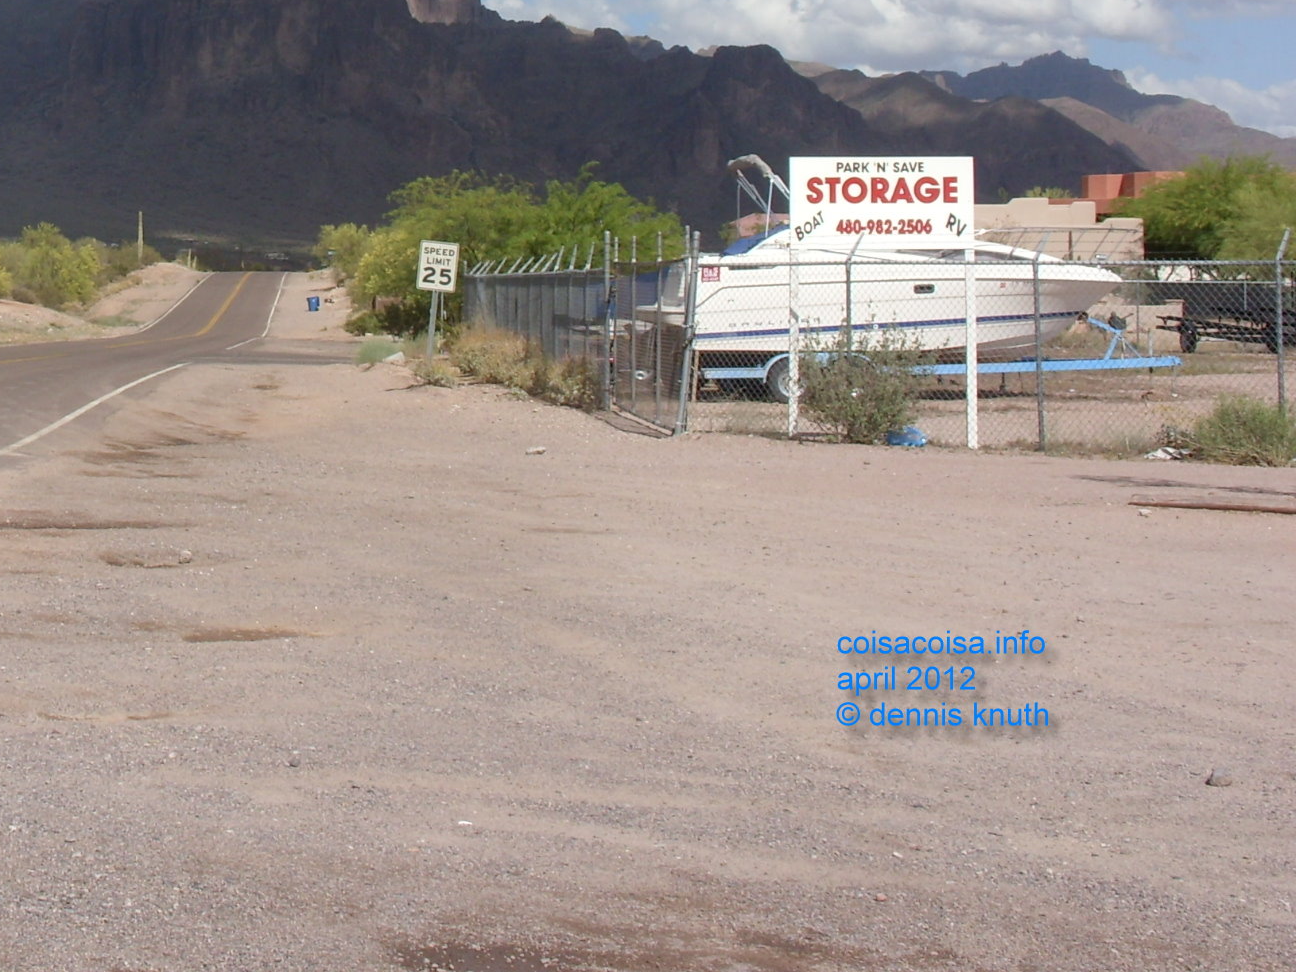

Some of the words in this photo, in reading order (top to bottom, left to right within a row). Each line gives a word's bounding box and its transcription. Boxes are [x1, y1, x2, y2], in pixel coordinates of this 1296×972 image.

[836, 162, 870, 173] PARK
[893, 162, 924, 173] SAVE
[806, 176, 958, 204] STORAGE
[795, 211, 824, 241] BOAT
[836, 219, 932, 234] 480-982-2506
[945, 213, 967, 237] RV
[424, 247, 455, 257] SPEED
[426, 257, 451, 266] LIMIT
[422, 267, 452, 285] 25
